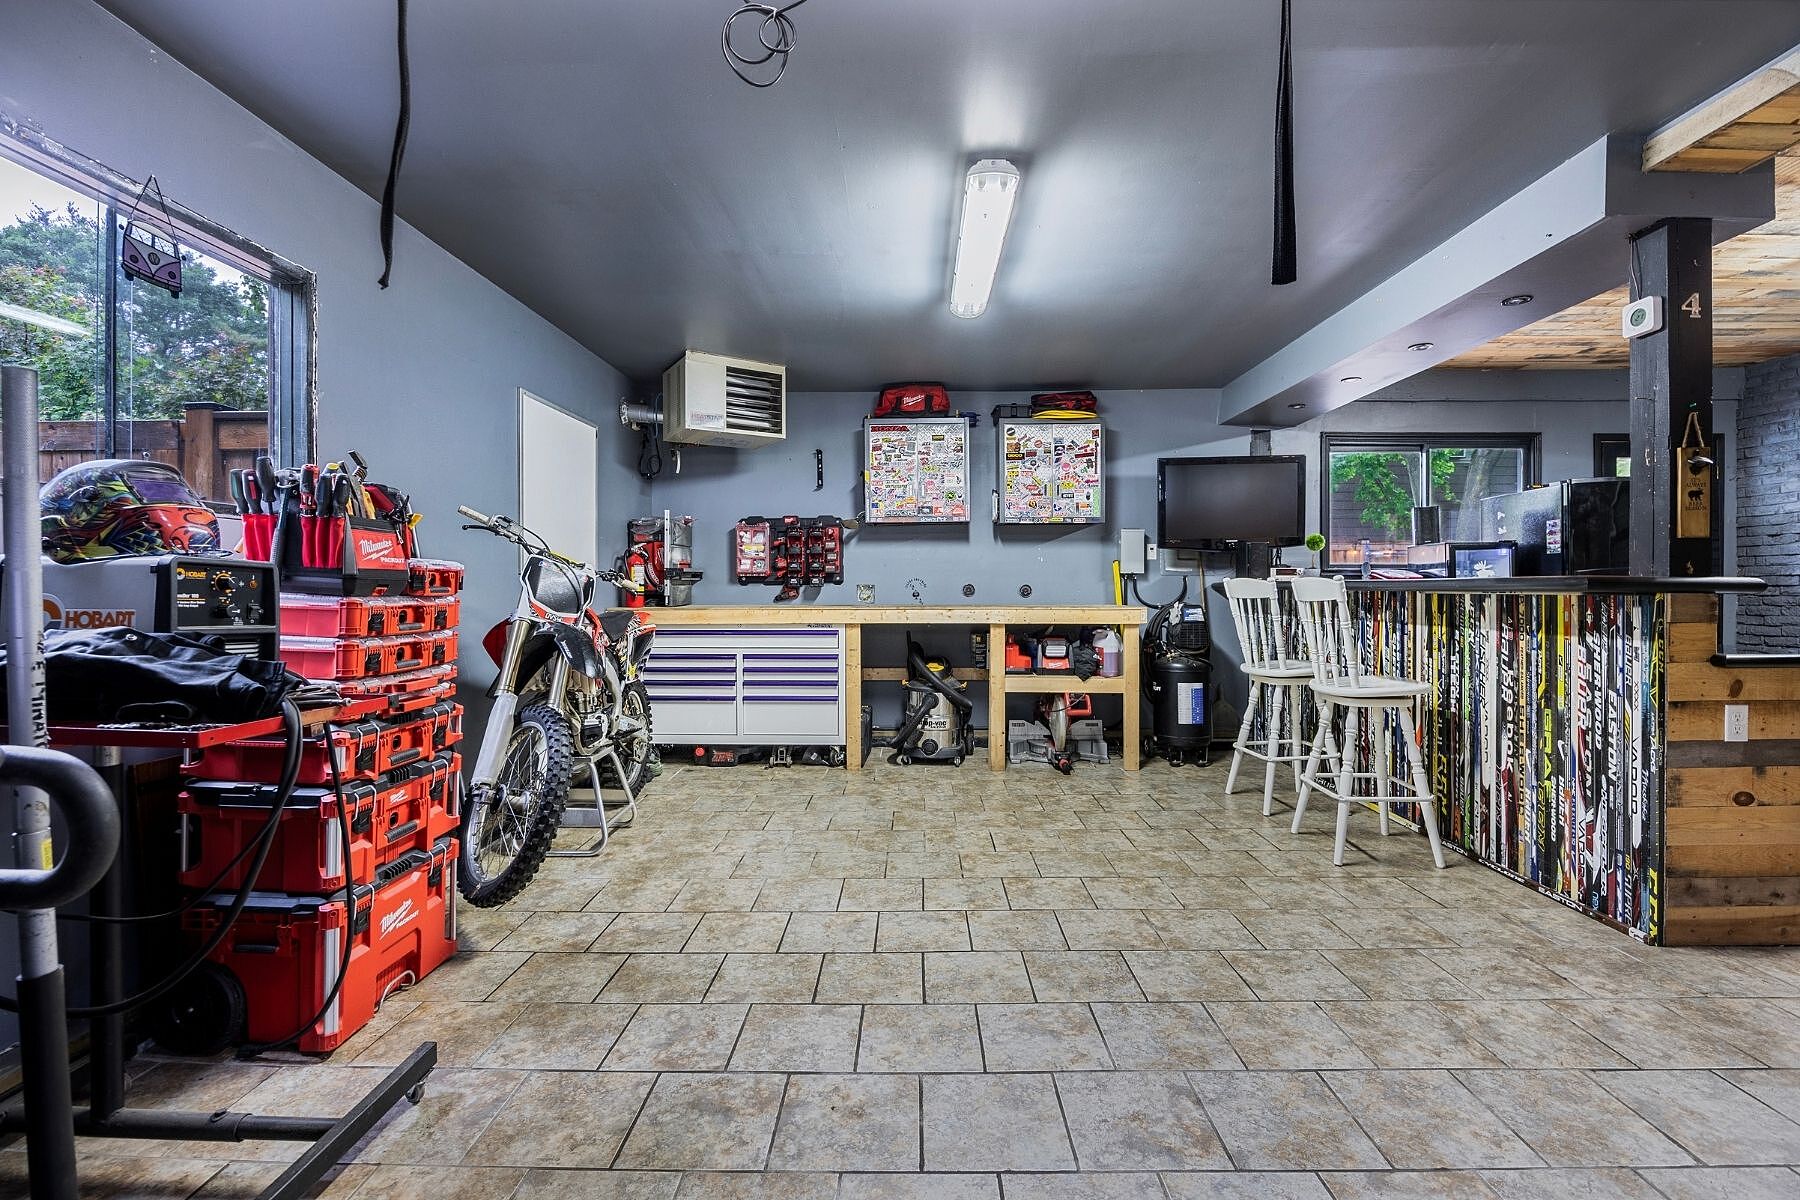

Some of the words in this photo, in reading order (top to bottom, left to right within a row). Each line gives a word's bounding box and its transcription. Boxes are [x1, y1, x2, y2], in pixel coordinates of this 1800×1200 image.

[1682, 292, 1703, 319] 4
[359, 539, 393, 556] Milwaukee
[65, 611, 136, 630] HOBART
[1593, 630, 1602, 751] SHER-WOOD
[1506, 669, 1514, 774] Reebok
[1584, 662, 1593, 799] EASTON
[1608, 689, 1618, 784] EASTON
[1543, 708, 1552, 804] GRAF
[1441, 840, 1468, 857] ASTON
[381, 898, 412, 931] Milwaukee
[1538, 886, 1583, 913] EASTON
[397, 911, 419, 928] PACKOUT
